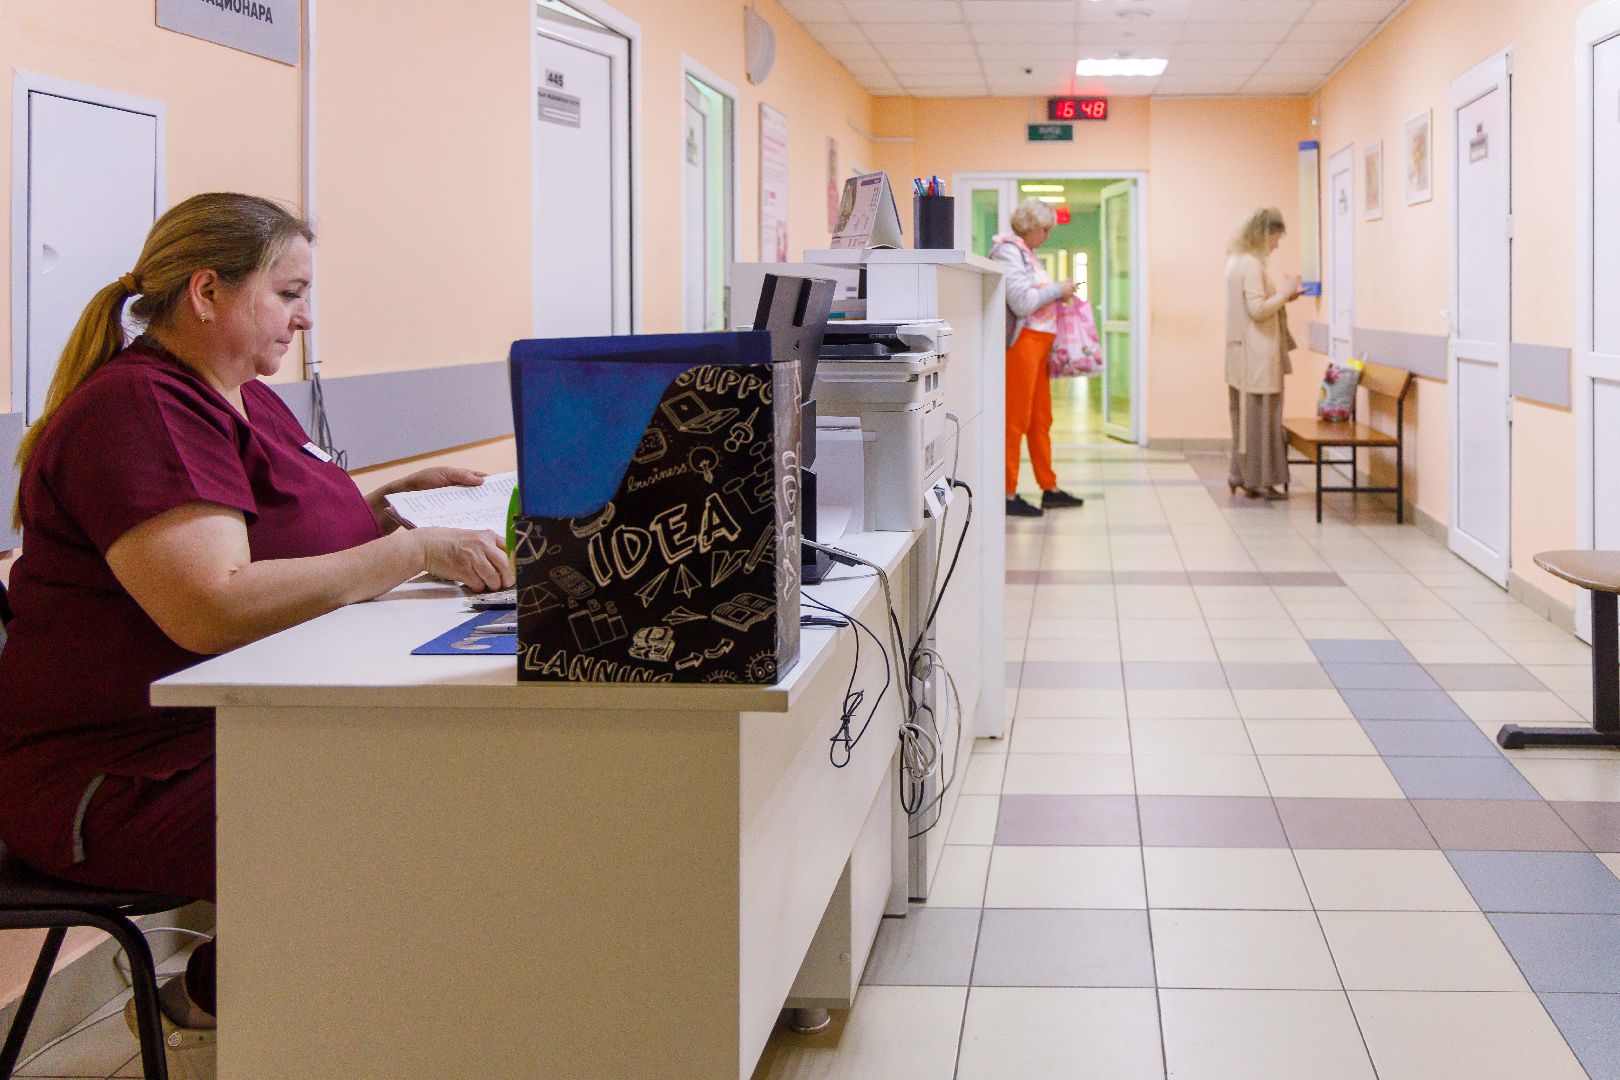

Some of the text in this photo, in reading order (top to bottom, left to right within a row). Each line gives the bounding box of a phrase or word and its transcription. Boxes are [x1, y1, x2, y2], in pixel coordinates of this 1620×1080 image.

[1080, 99, 1106, 118] 48
[627, 463, 688, 493] business
[586, 492, 741, 587] IDEA
